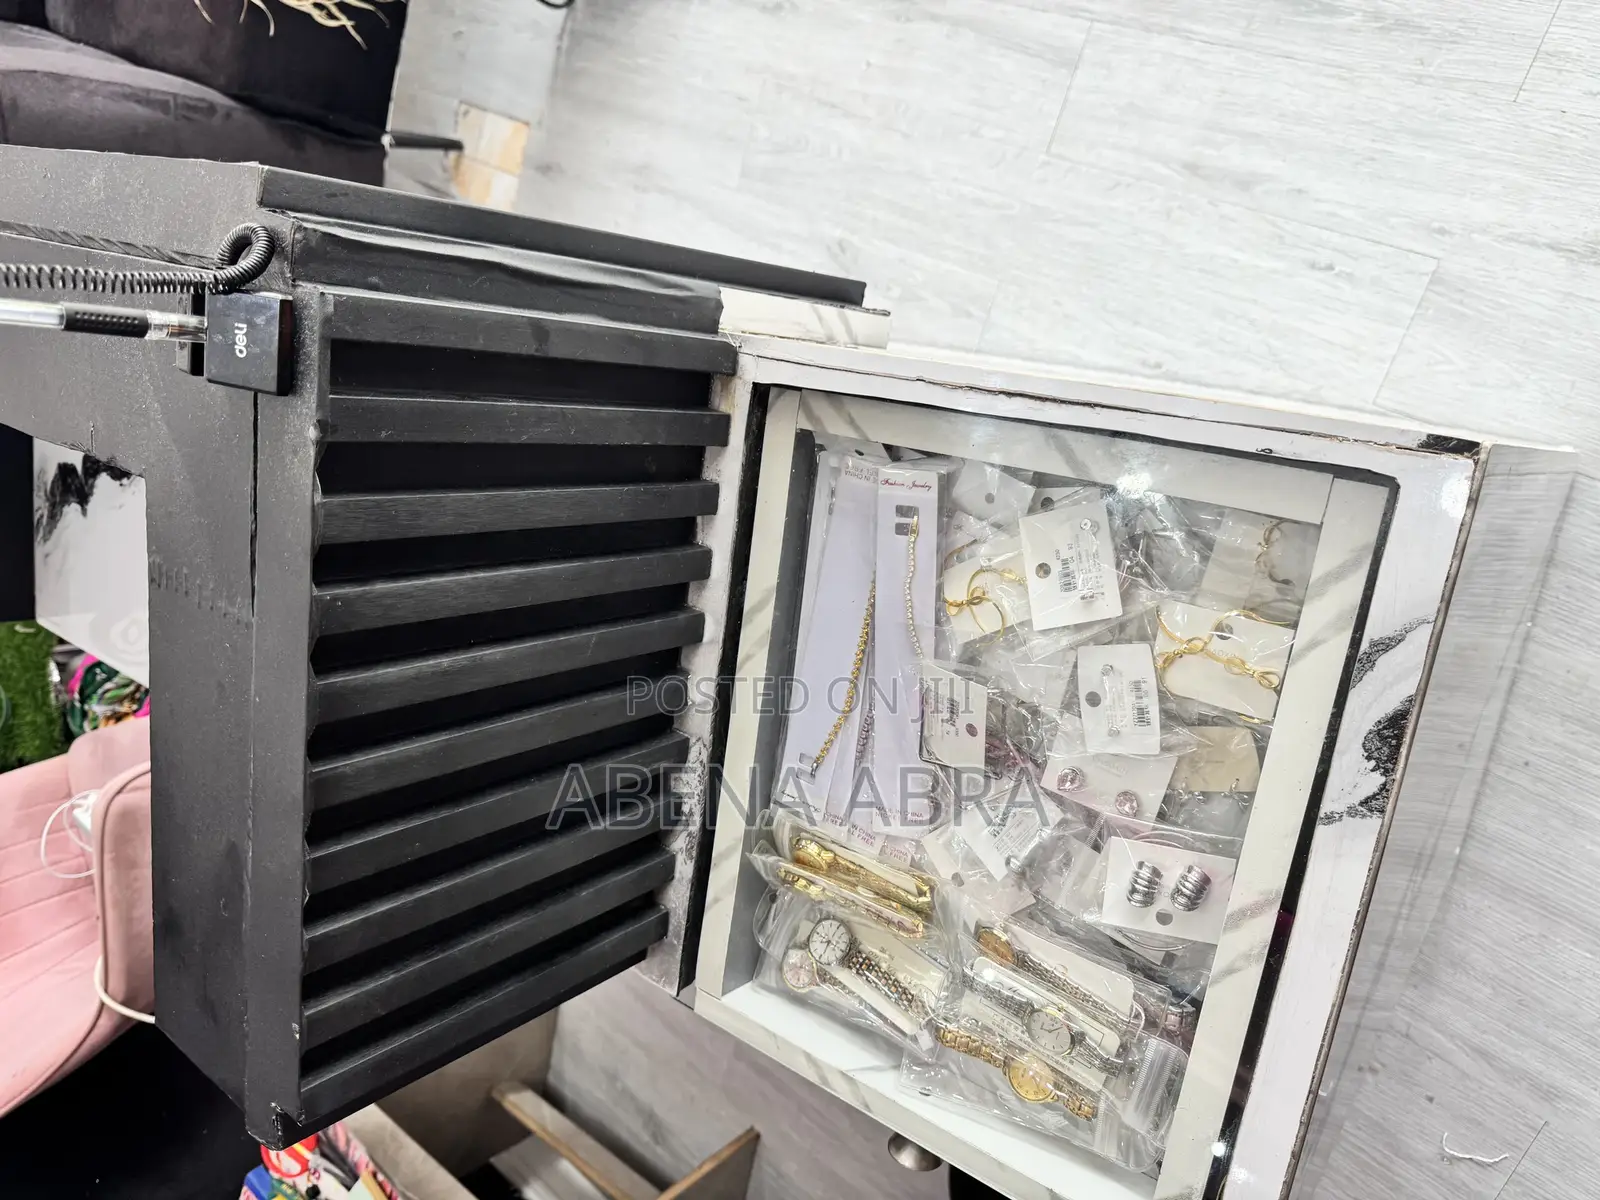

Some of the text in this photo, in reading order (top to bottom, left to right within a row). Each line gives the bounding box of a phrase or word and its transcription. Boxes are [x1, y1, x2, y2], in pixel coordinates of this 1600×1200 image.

[234, 322, 248, 358] deli
[857, 834, 875, 848] FREE
[858, 827, 876, 841] CHINA
